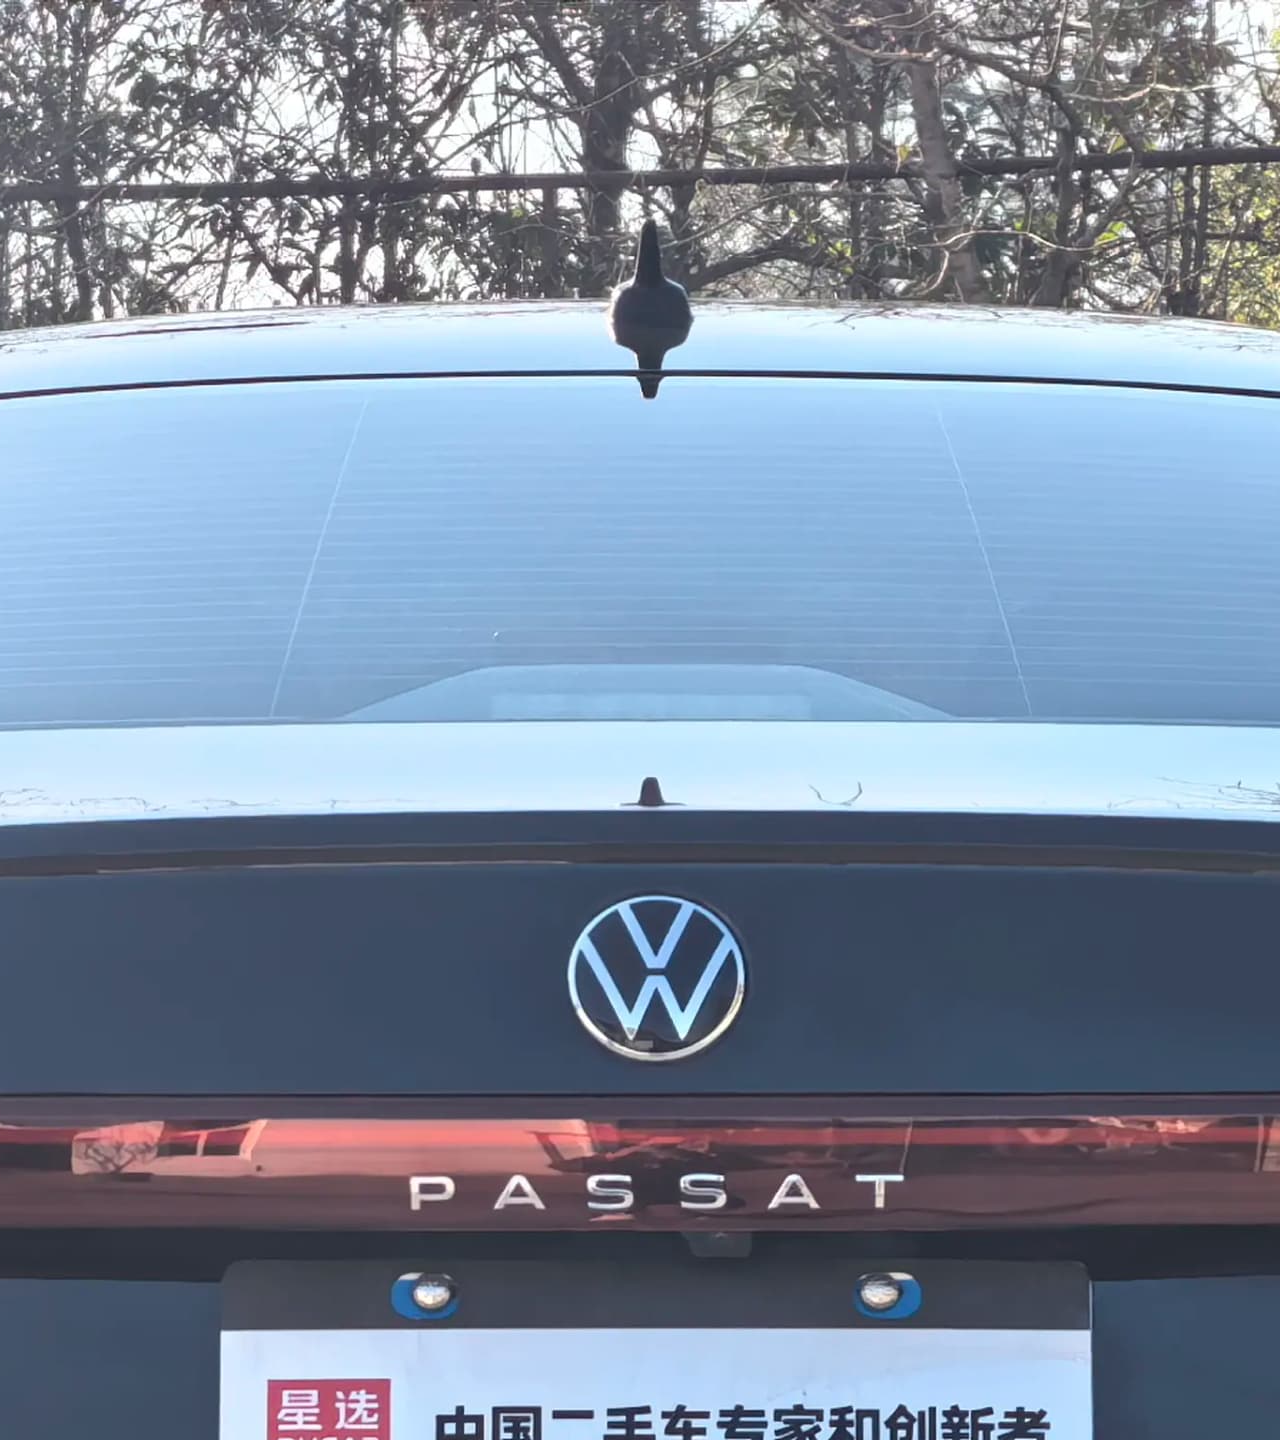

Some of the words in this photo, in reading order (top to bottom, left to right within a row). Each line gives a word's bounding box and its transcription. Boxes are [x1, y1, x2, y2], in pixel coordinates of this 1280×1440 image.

[578, 902, 734, 1041] VW
[409, 1173, 905, 1211] PASSAT
[277, 1389, 380, 1432] 星选
